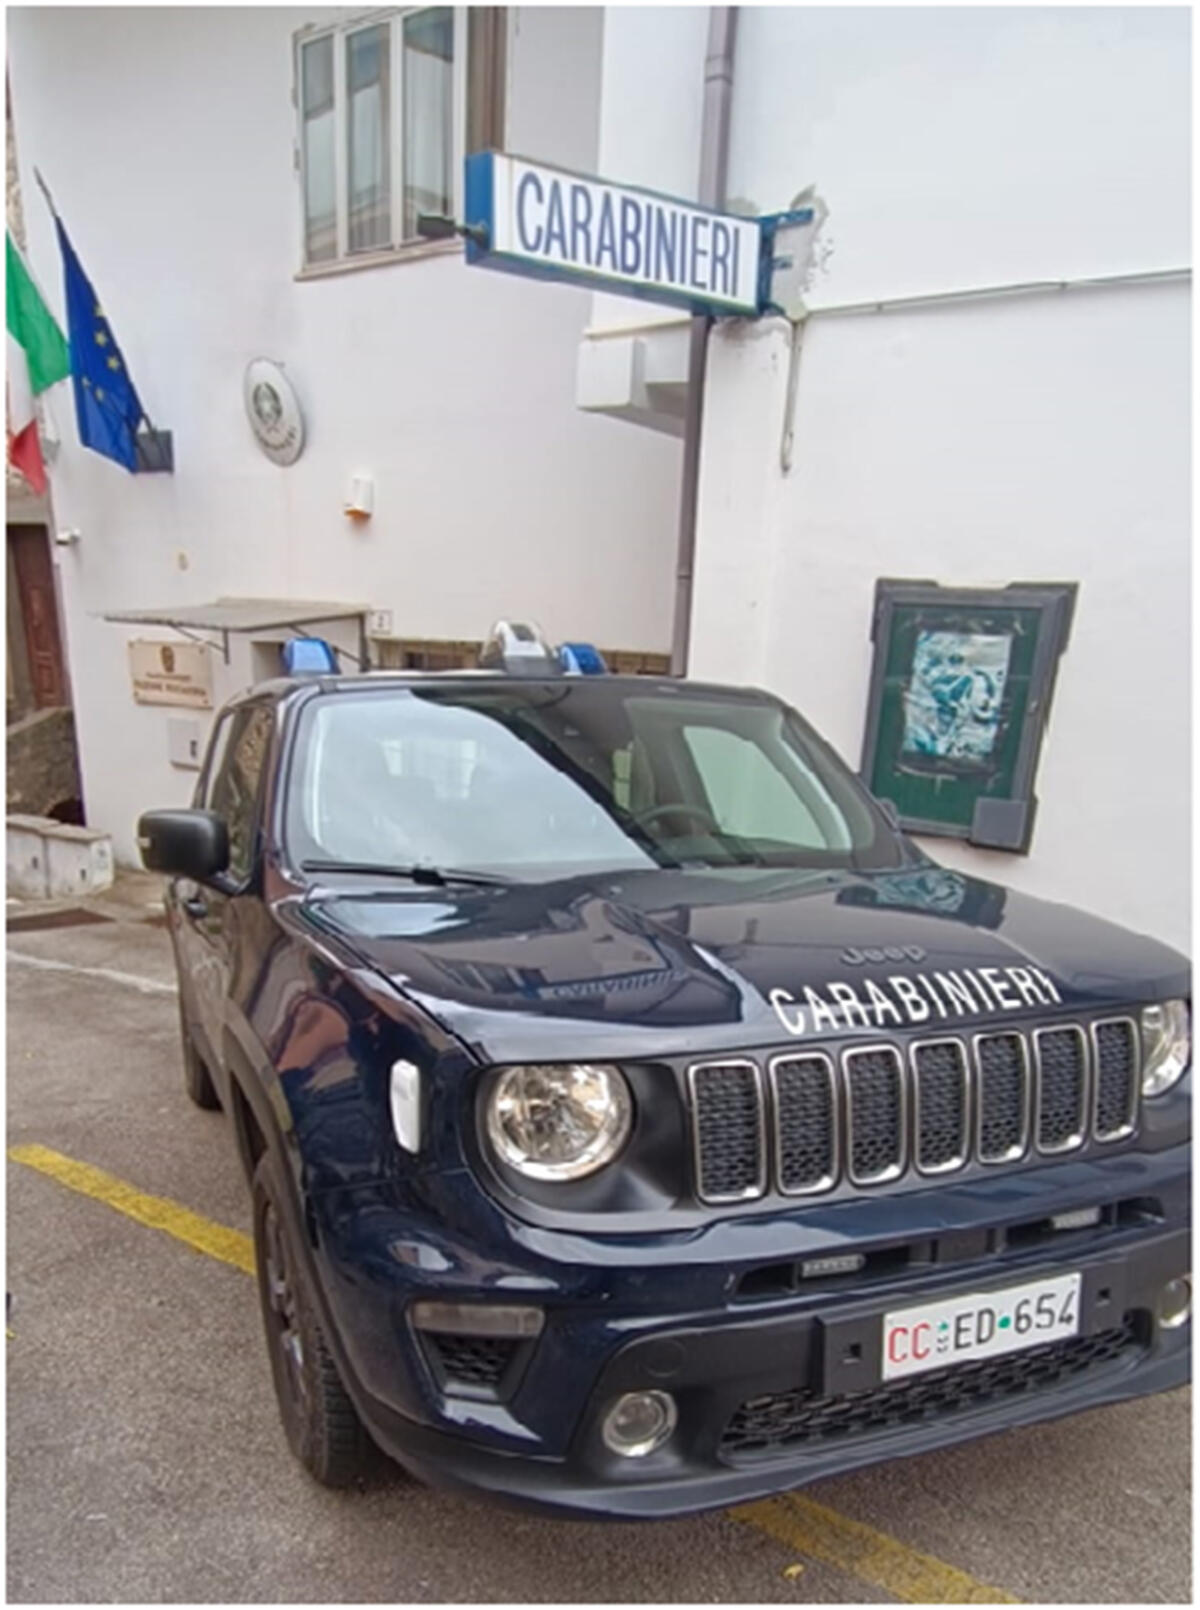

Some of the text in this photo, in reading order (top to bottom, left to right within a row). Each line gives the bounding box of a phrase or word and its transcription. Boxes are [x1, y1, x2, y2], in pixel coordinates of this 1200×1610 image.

[517, 172, 740, 297] CARABINIERI
[841, 944, 926, 965] Jeep
[769, 965, 1061, 1034] CARABINIERI
[888, 1324, 931, 1363] CC
